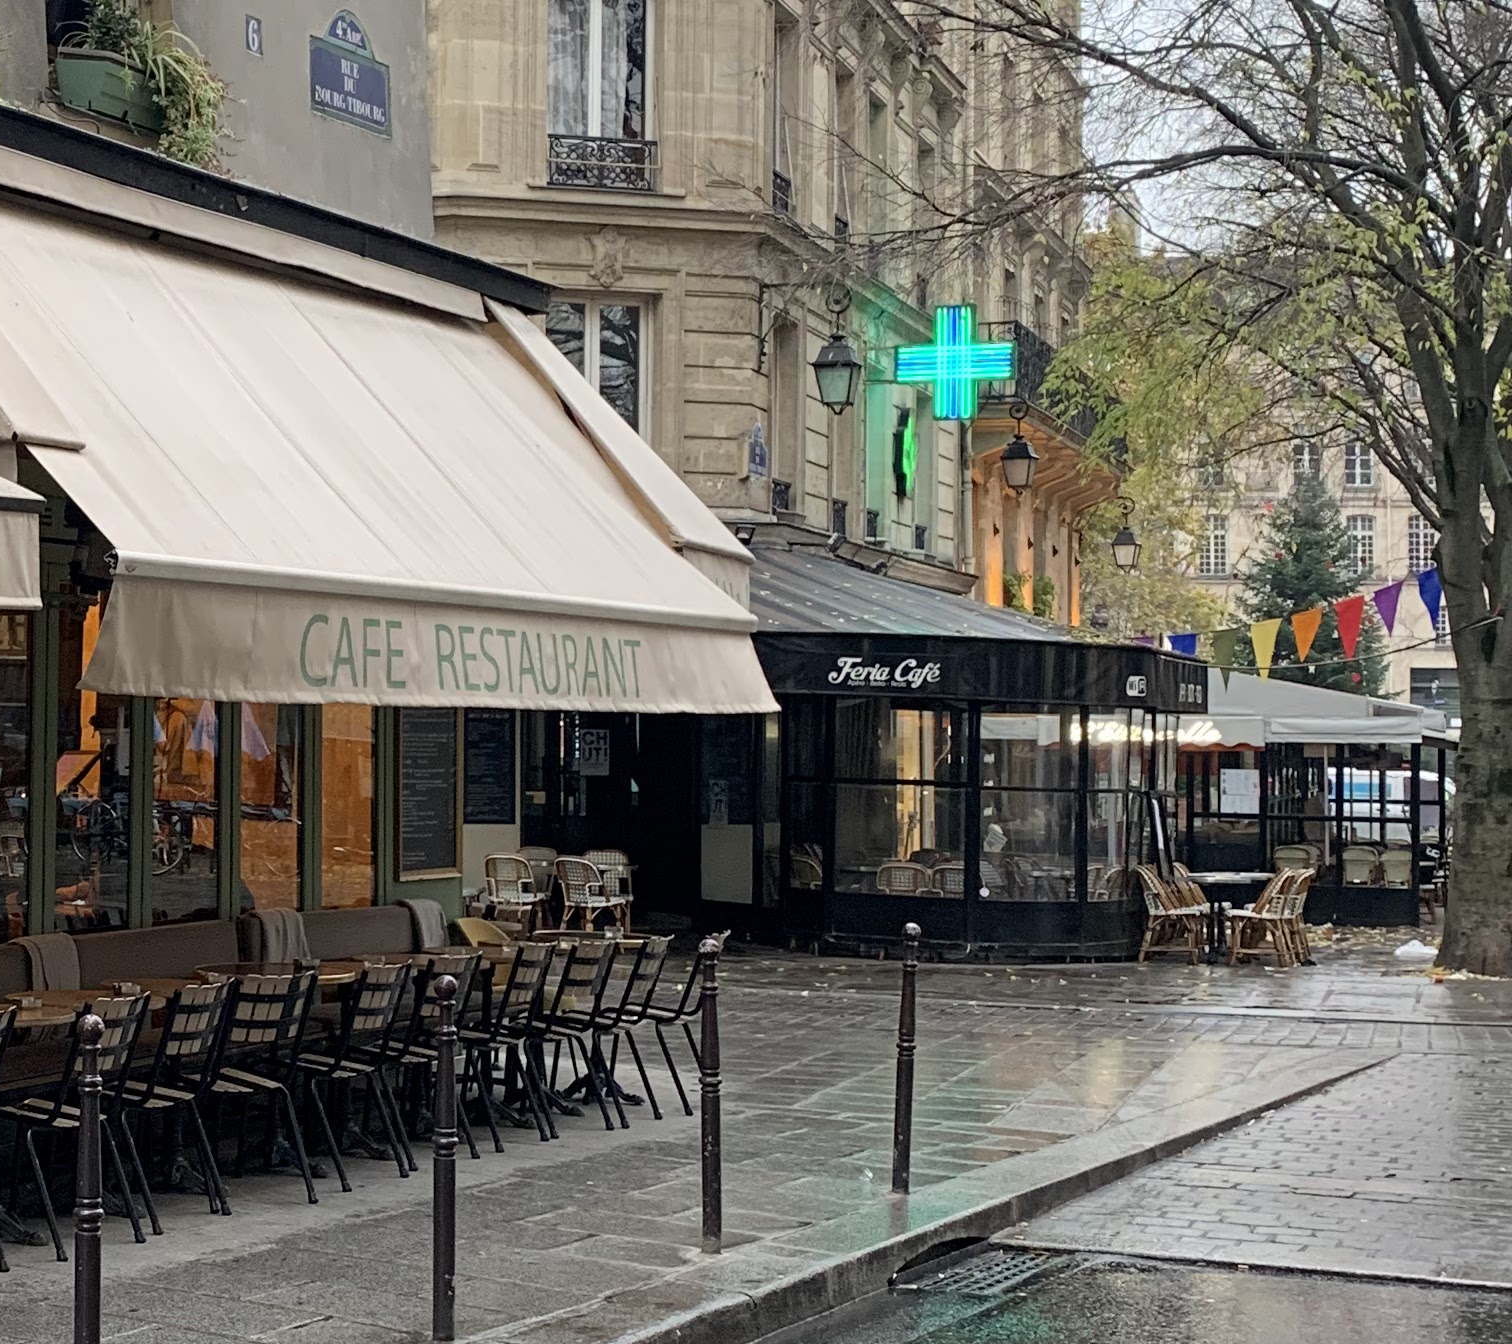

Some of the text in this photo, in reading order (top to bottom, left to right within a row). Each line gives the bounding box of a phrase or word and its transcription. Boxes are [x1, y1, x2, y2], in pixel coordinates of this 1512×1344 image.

[248, 19, 259, 52] 6
[341, 58, 359, 79] RUE
[344, 76, 357, 94] DU
[315, 85, 385, 123] BOURG TIBOURG
[299, 613, 642, 698] CAFE RESTAURANT
[828, 657, 941, 689] Feria Café
[582, 731, 608, 746] CH
